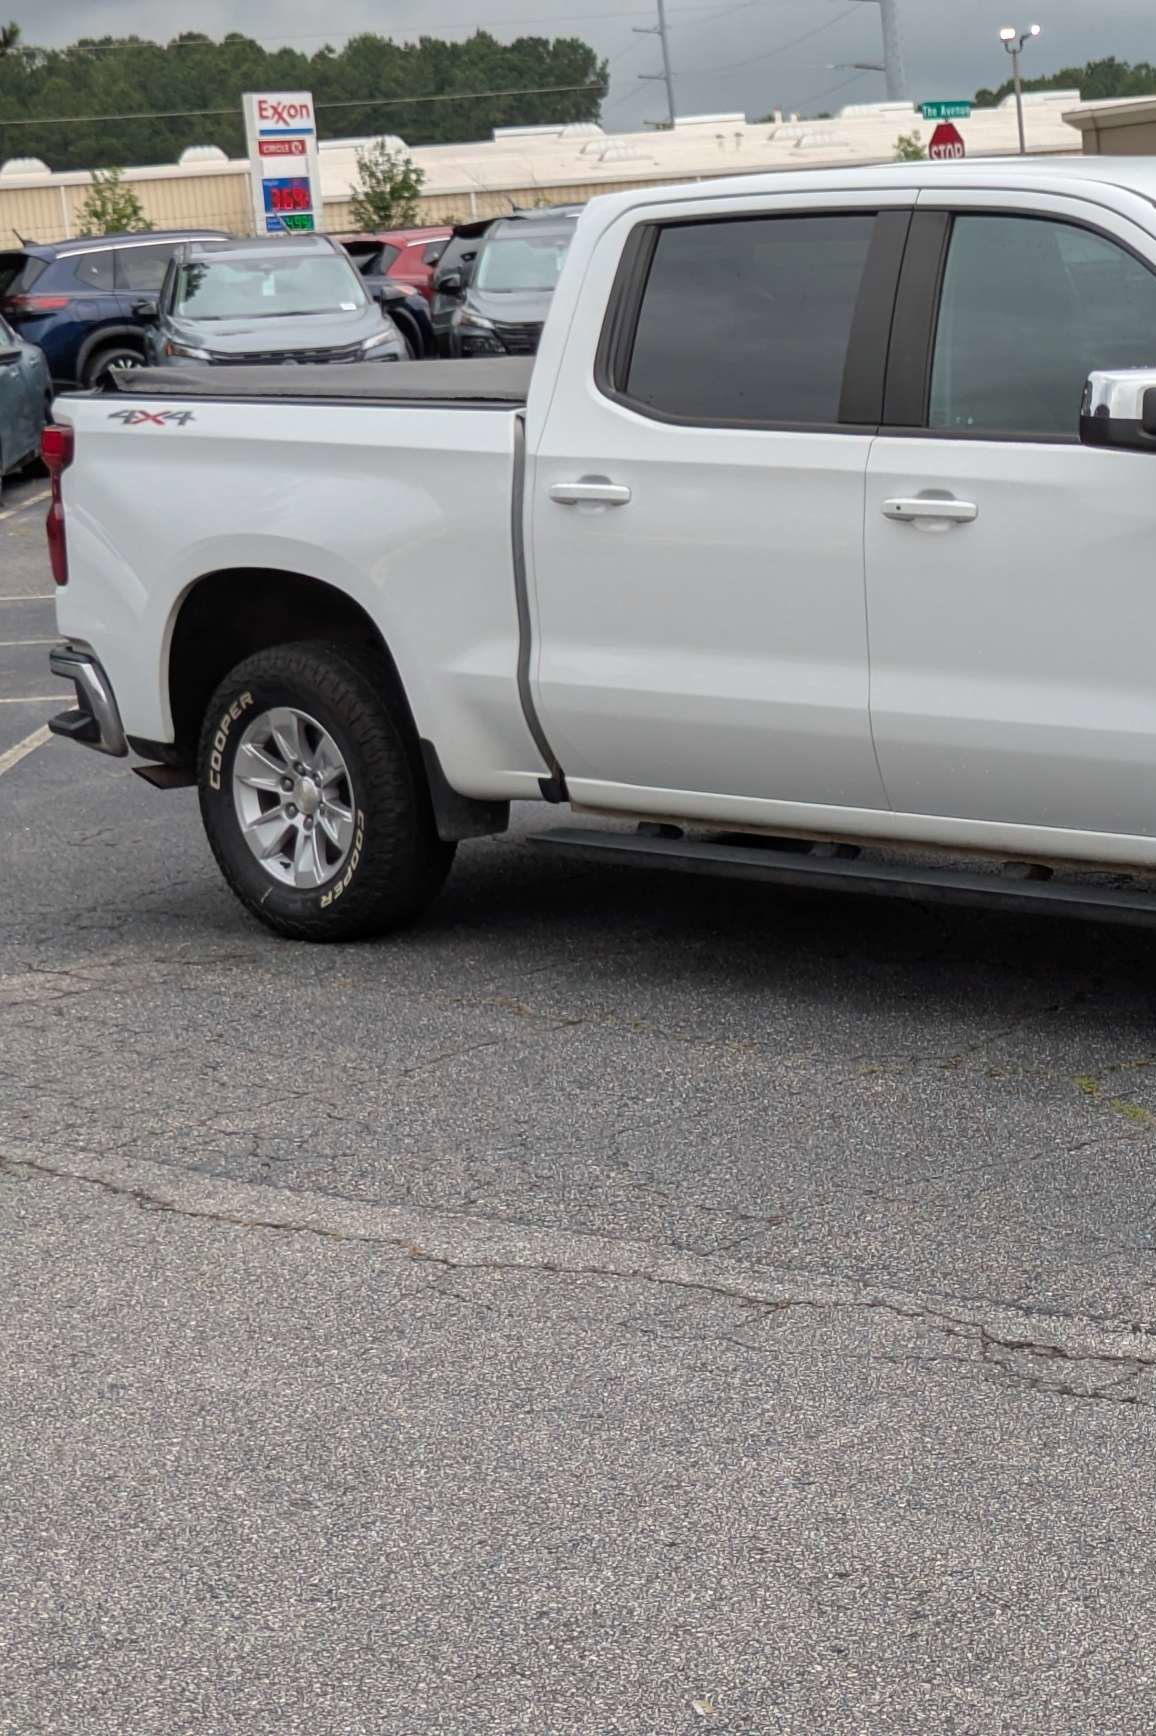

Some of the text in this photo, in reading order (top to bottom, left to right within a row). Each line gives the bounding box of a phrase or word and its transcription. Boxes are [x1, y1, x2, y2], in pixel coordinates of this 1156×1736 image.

[258, 100, 310, 126] Exxon
[923, 105, 937, 117] The
[931, 143, 963, 159] STOP
[209, 691, 254, 790] COOPER
[319, 808, 365, 909] COOPER
